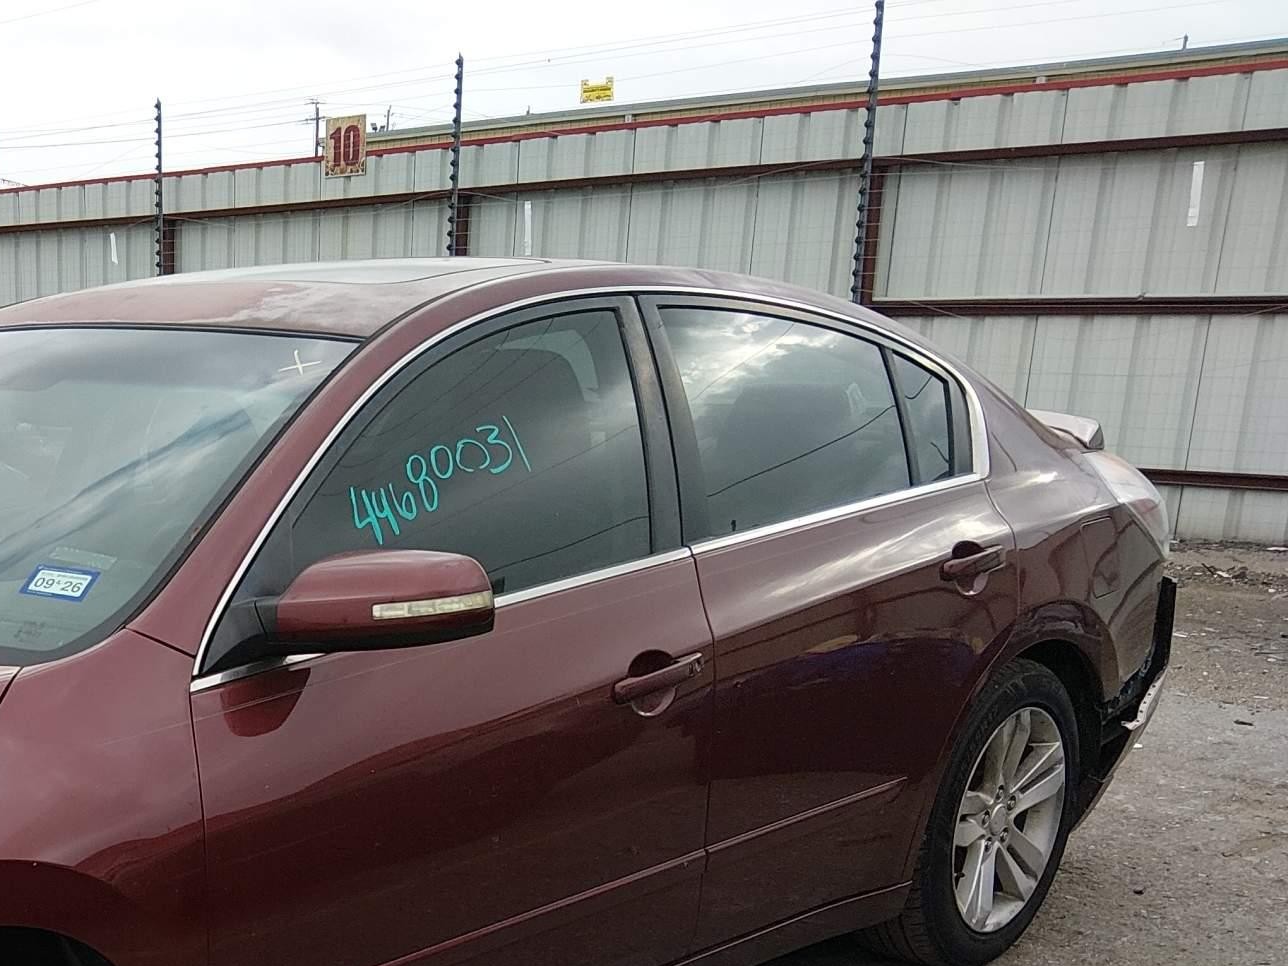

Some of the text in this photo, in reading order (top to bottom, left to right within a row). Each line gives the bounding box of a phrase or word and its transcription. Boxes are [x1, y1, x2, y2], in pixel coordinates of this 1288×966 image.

[329, 125, 361, 167] 10
[348, 415, 532, 545] 44680031
[33, 577, 83, 593] 09 26
